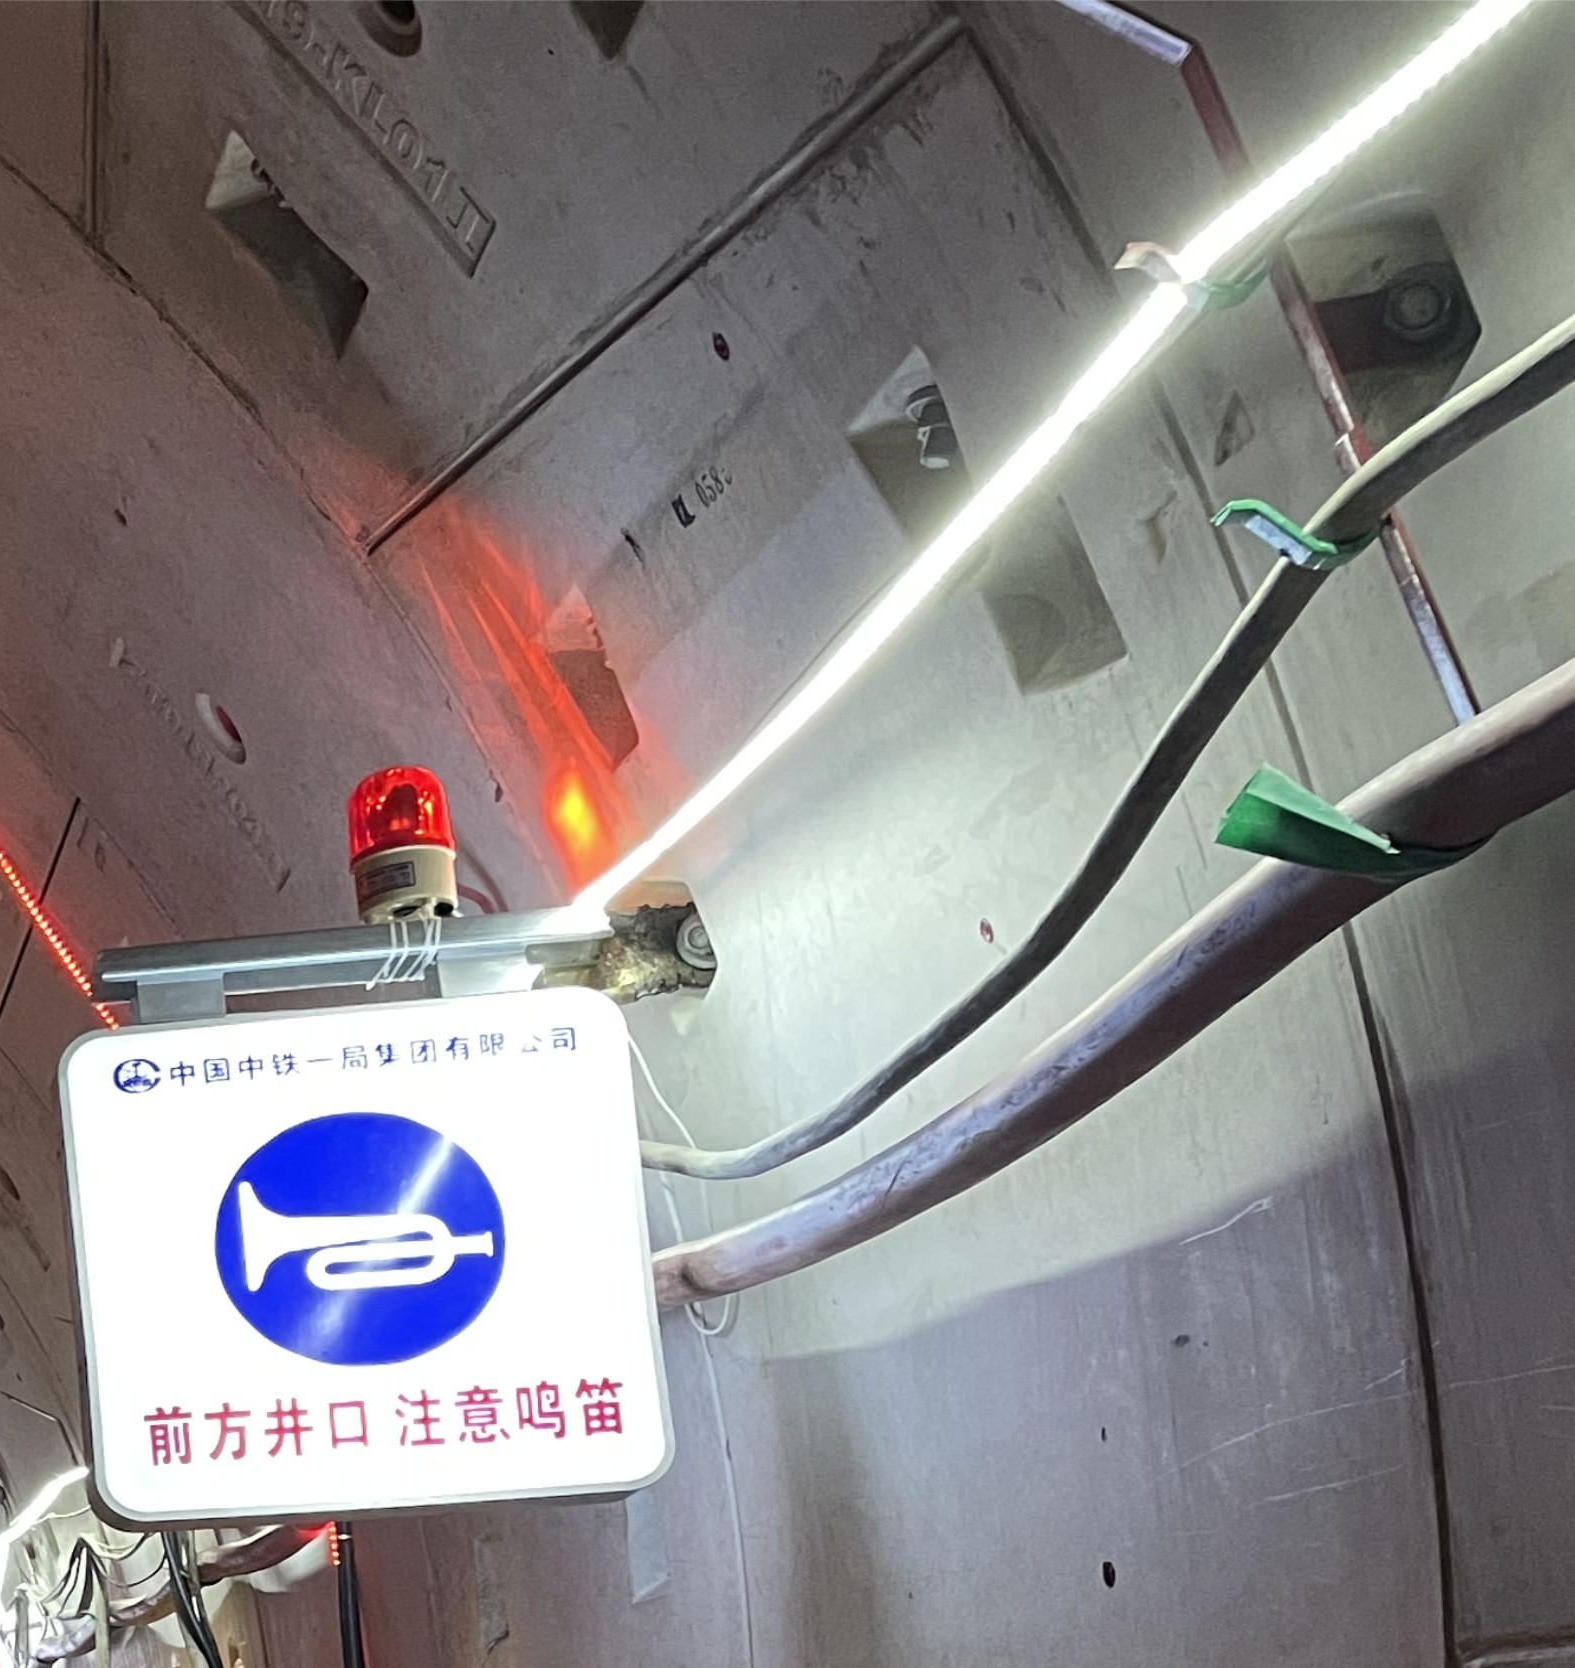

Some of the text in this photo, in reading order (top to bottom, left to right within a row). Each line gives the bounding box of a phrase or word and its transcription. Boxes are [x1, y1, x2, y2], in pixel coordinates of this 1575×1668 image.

[170, 1026, 578, 1087] 中国中铁一局集团有限公司
[144, 1378, 624, 1466] 前方井口 注意鸣笛
